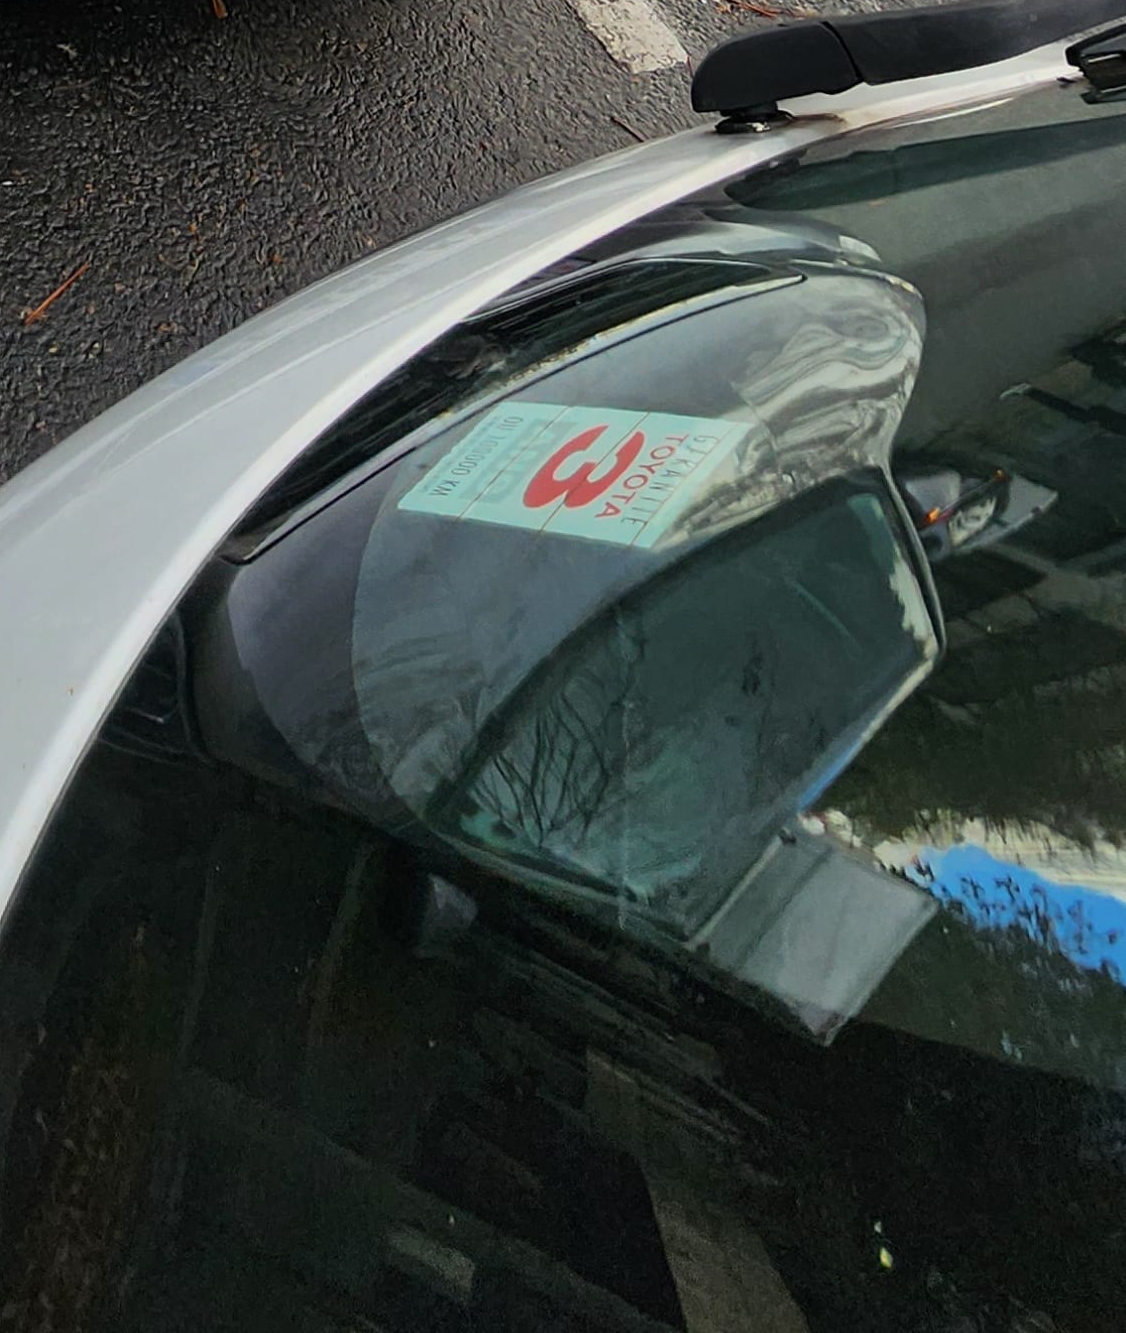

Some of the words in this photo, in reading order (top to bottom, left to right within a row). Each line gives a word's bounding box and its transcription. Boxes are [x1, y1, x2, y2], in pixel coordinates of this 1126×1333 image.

[429, 479, 460, 497] KM
[522, 424, 645, 509] 3
[594, 432, 690, 518] TOYOTA
